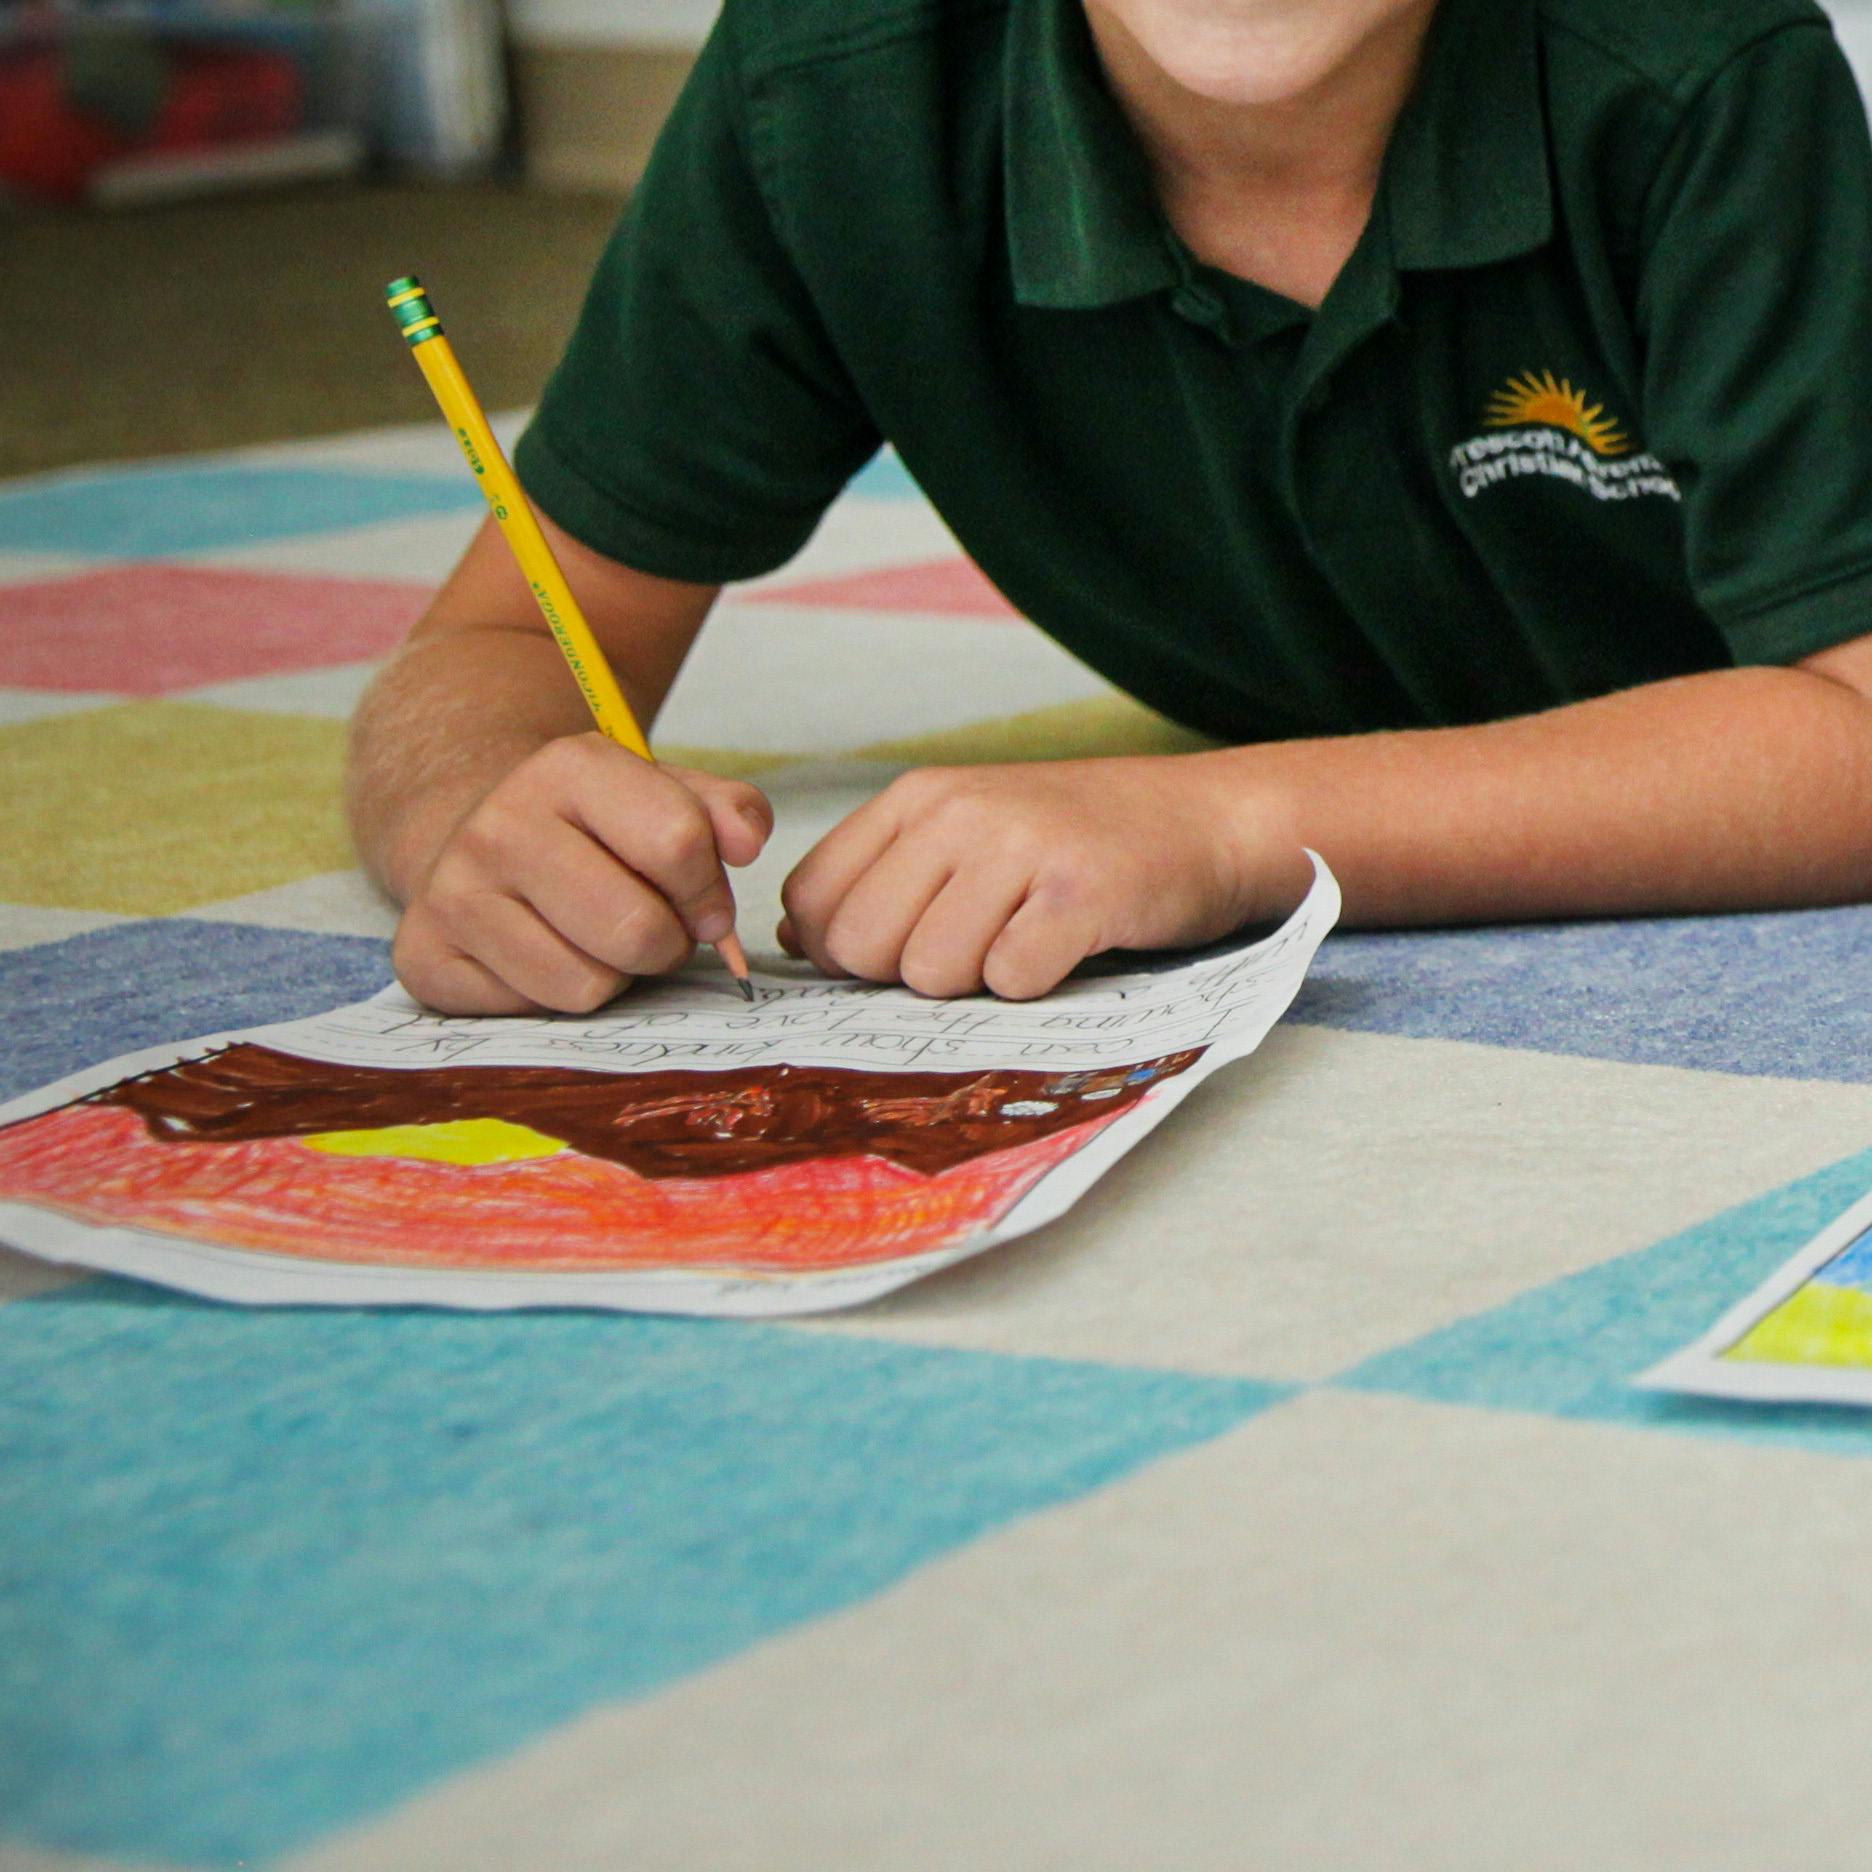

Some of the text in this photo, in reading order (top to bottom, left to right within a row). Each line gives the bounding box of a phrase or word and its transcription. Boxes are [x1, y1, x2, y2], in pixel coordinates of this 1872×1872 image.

[726, 1008, 867, 1032] love
[895, 1012, 1001, 1036] the
[394, 1031, 490, 1063] by
[550, 1038, 784, 1068] kindness
[820, 1033, 966, 1066] show
